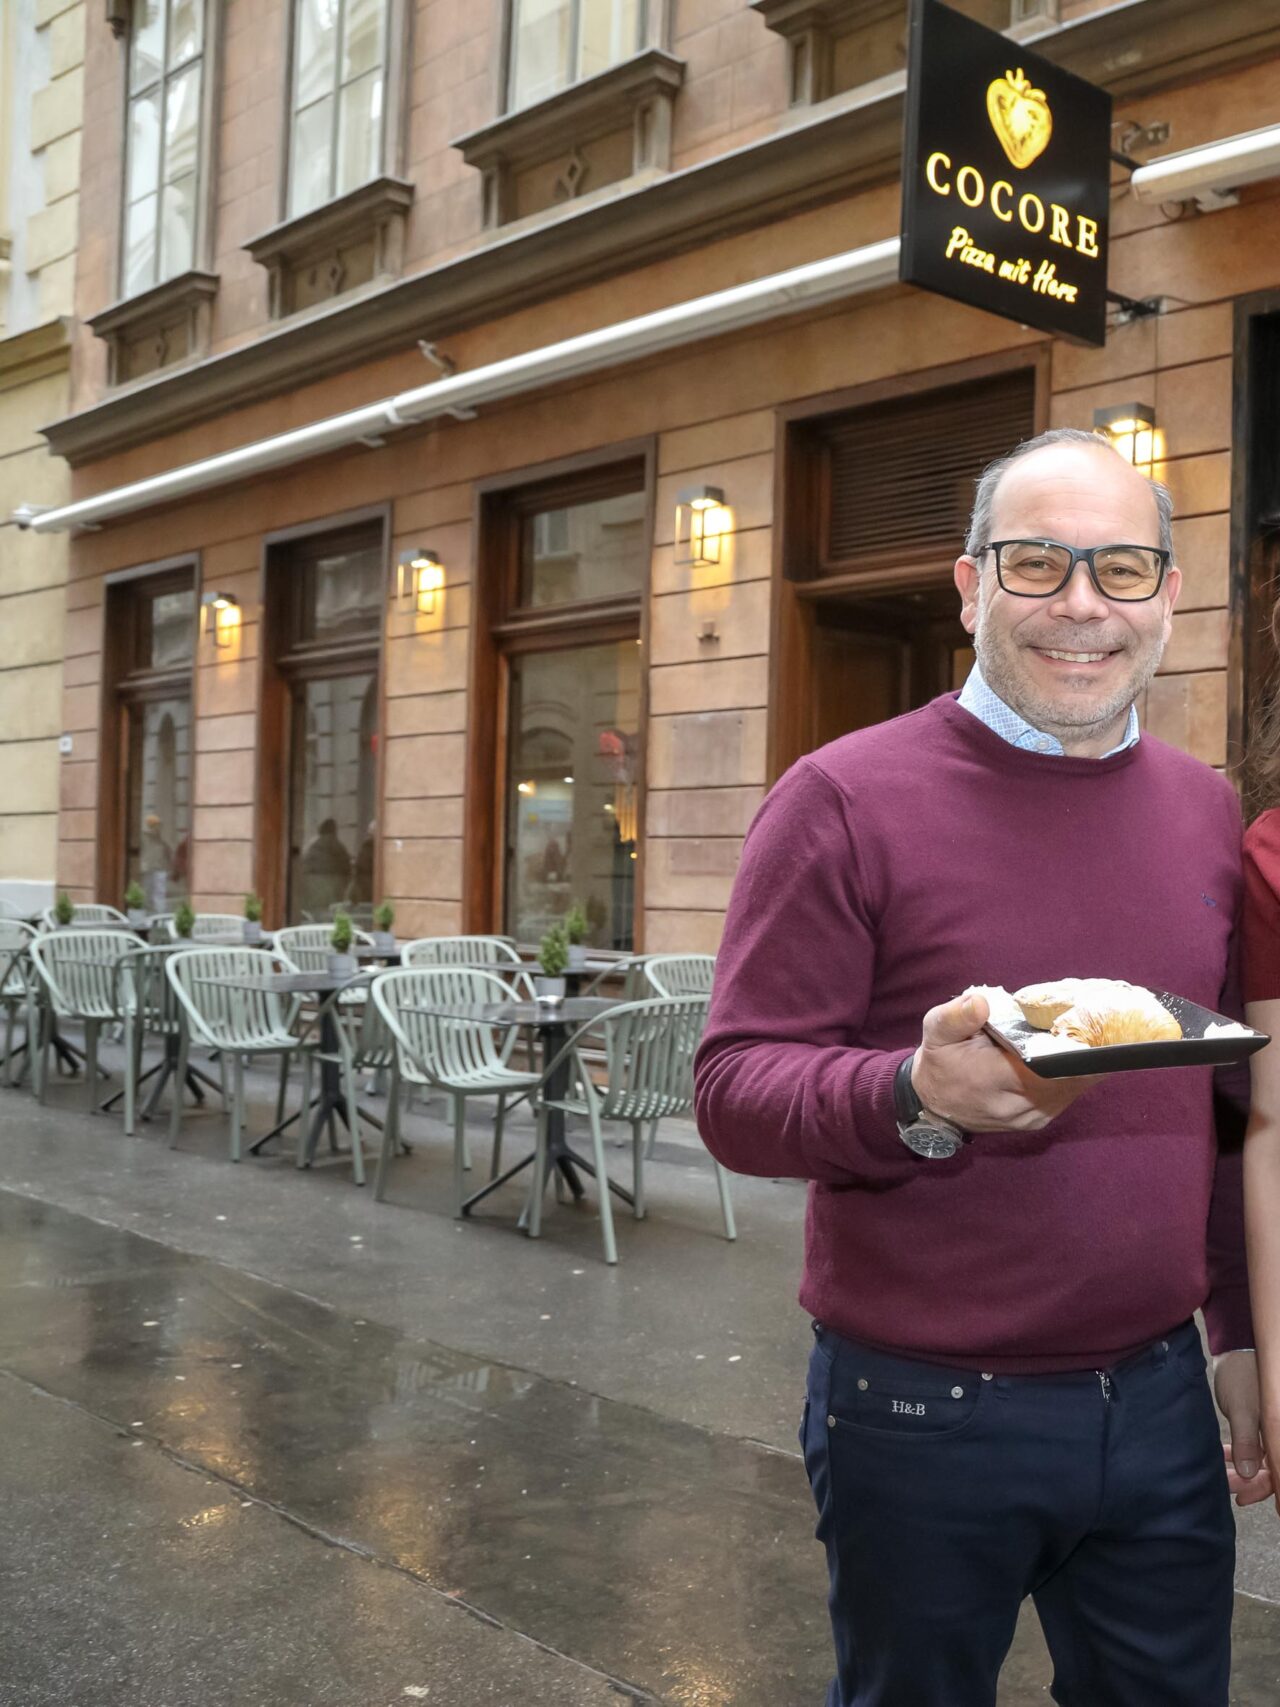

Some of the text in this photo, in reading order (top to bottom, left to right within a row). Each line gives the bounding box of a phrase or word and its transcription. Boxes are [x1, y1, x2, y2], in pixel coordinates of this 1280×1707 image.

[926, 152, 1099, 258] COCORE
[945, 226, 1079, 303] Pizza mit Herz
[891, 1400, 926, 1416] H&B
